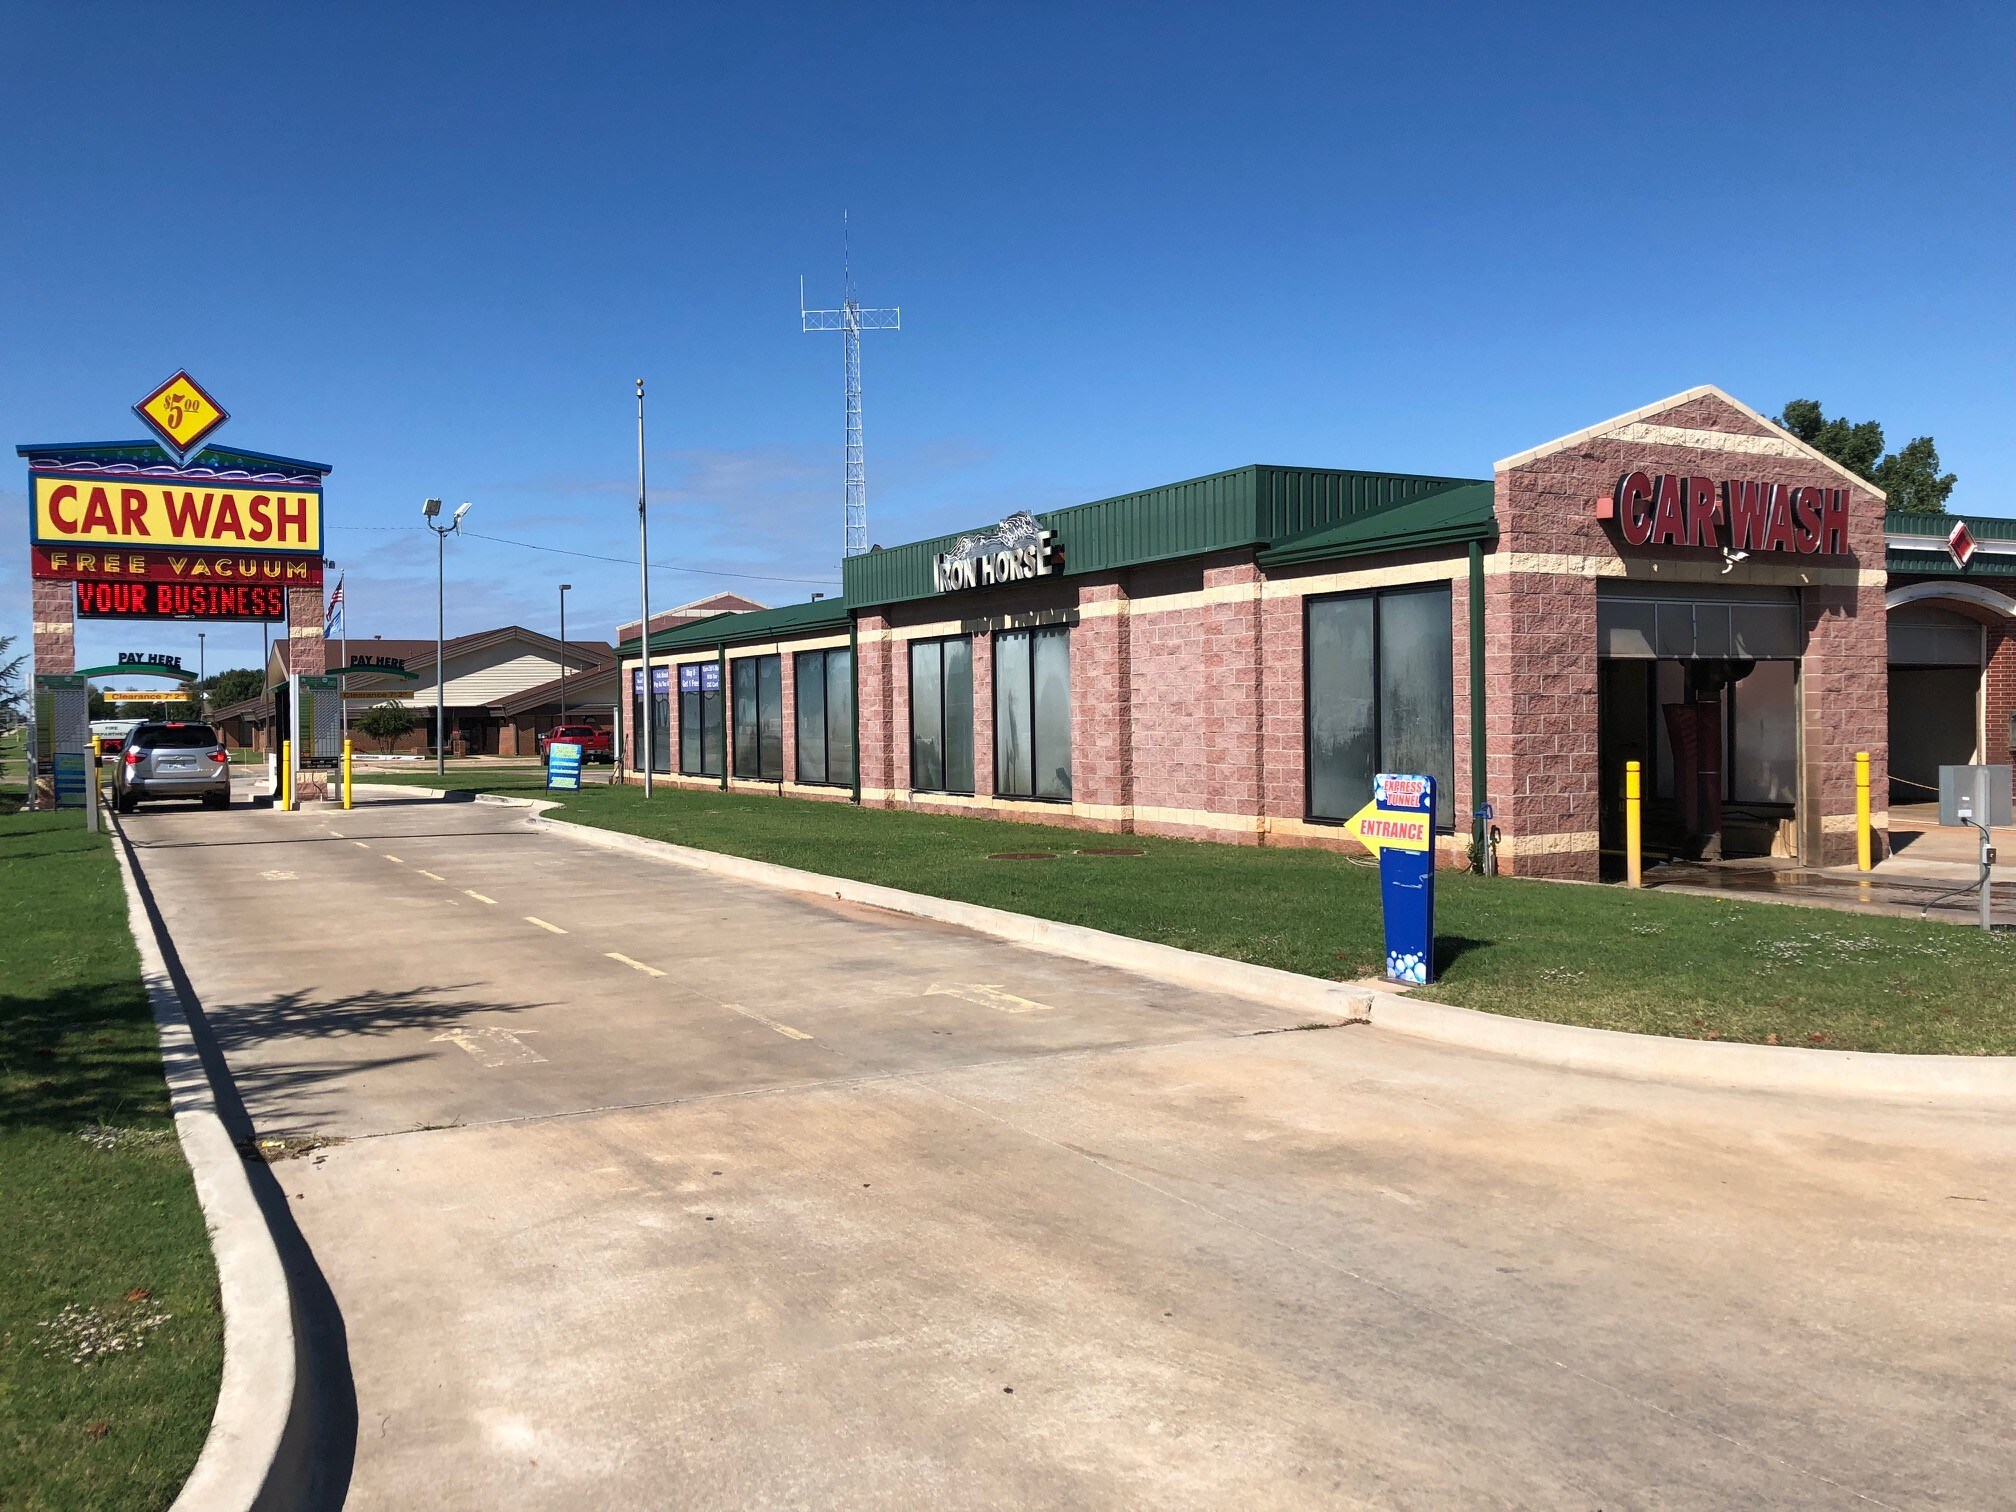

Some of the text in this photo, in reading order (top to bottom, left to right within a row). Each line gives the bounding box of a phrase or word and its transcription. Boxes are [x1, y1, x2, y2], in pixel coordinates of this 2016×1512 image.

[49, 485, 306, 542] CAR WASH
[1614, 471, 1850, 555] CAR WASH
[51, 552, 307, 578] FREE VACUUM
[934, 530, 1053, 593] IRON HORSE
[78, 583, 281, 615] YOUR BUSINESS
[118, 652, 182, 667] PAY HERE
[350, 655, 406, 669] PAY HERE
[1384, 780, 1423, 794] EXPRESS
[1387, 793, 1420, 806] TUNNEL
[1360, 819, 1424, 841] ENTRANCE
